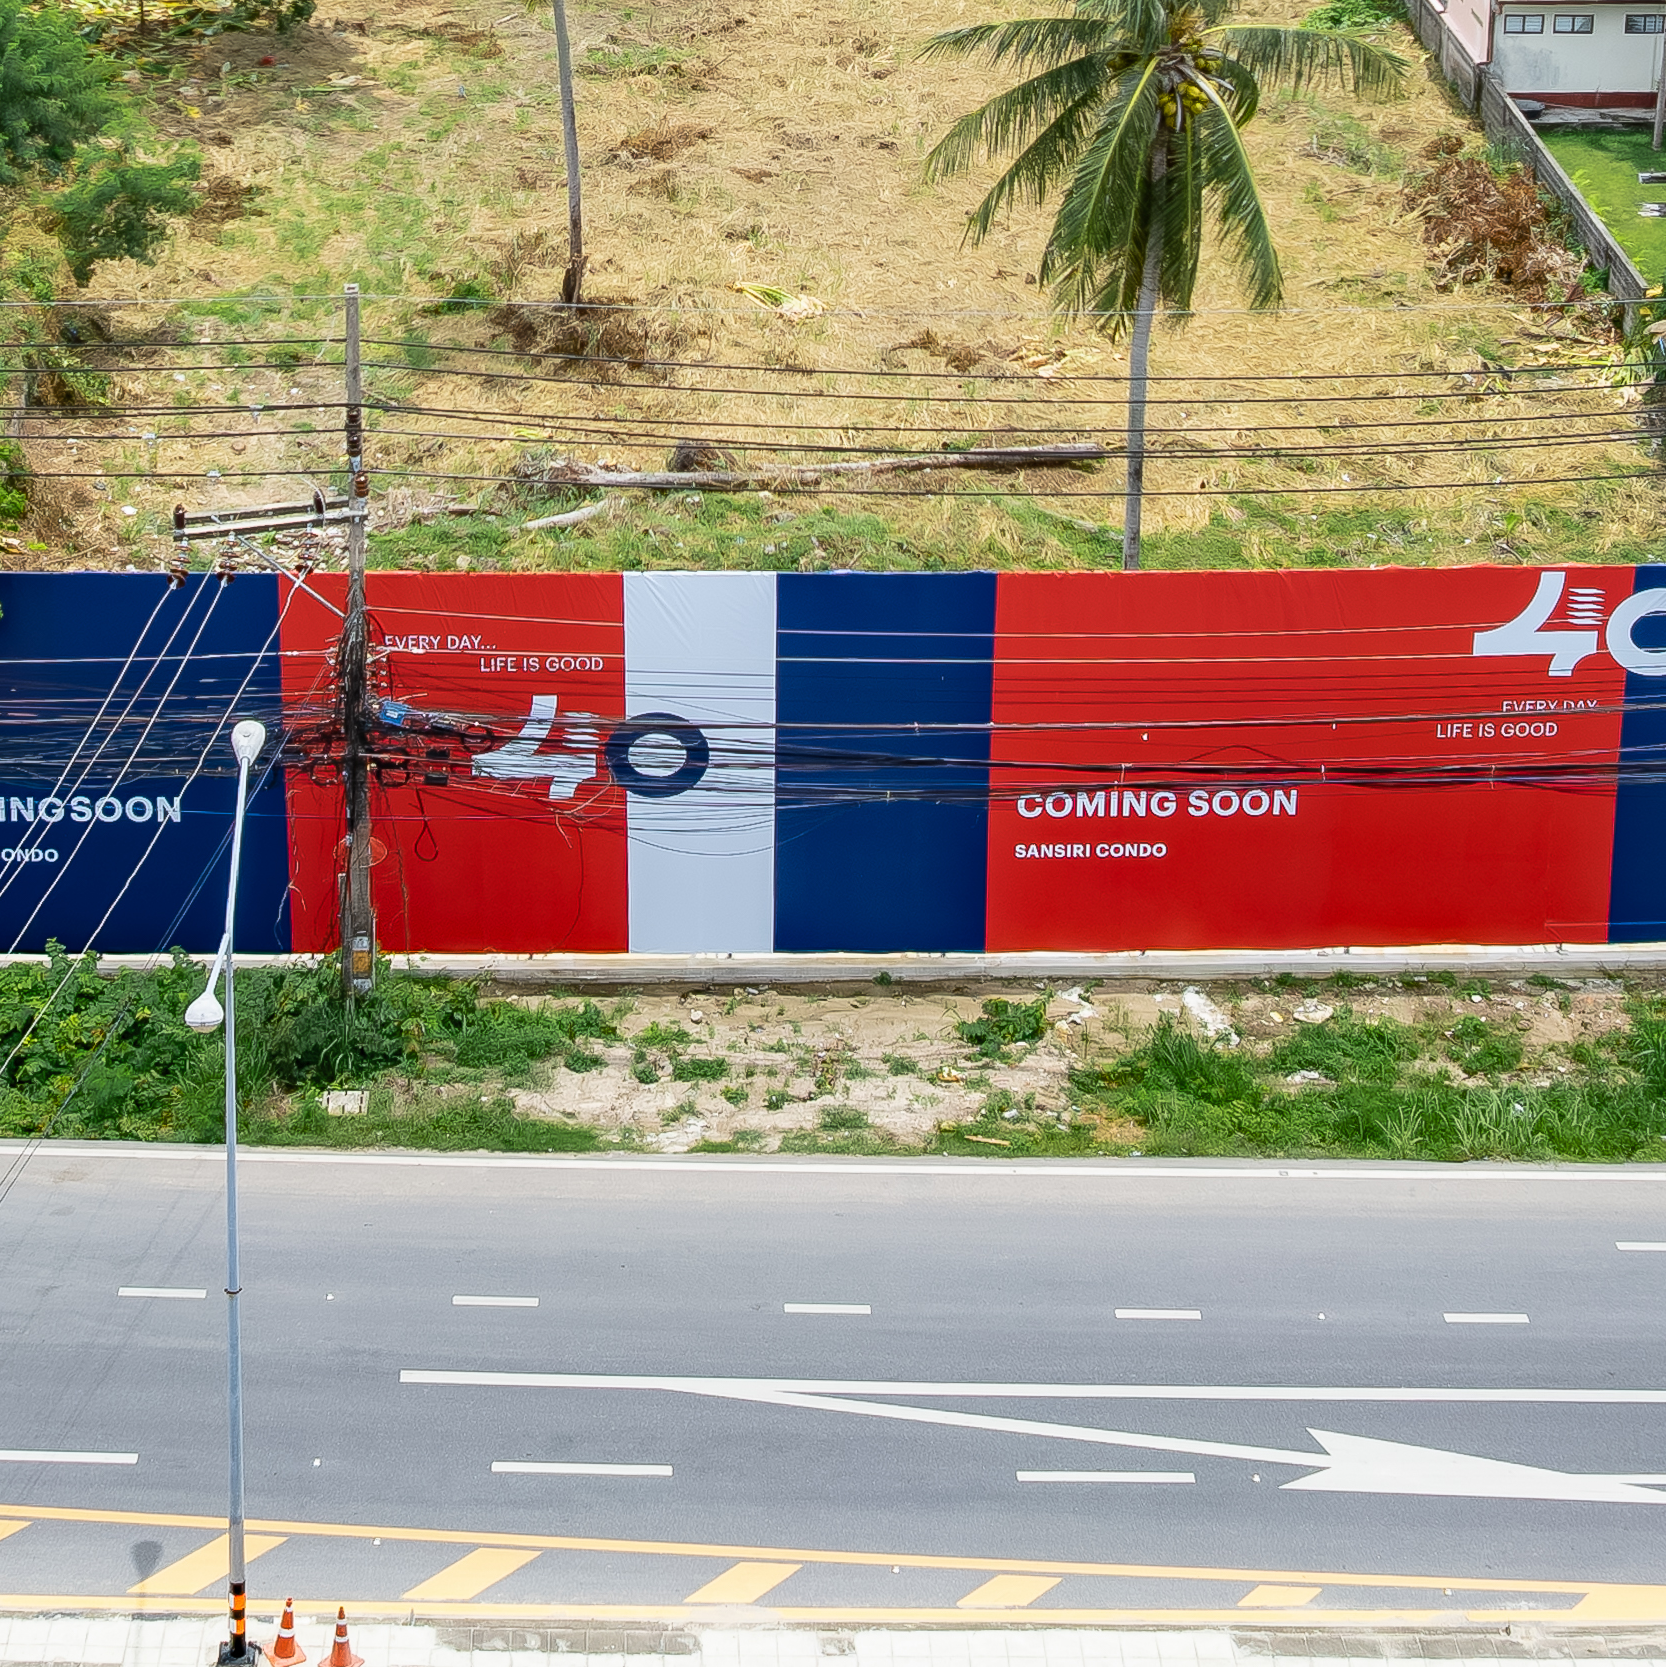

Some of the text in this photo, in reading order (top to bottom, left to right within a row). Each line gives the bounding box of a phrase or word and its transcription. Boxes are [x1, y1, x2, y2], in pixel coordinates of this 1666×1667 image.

[384, 635, 440, 651] EVERY
[480, 657, 604, 672] LIFE IS GOOD
[1502, 700, 1558, 712] EVERY
[1436, 722, 1558, 738] LIFE IS GOOD
[1017, 789, 1298, 818] COMING SOON
[1015, 843, 1167, 858] SANSIRI CONDO
